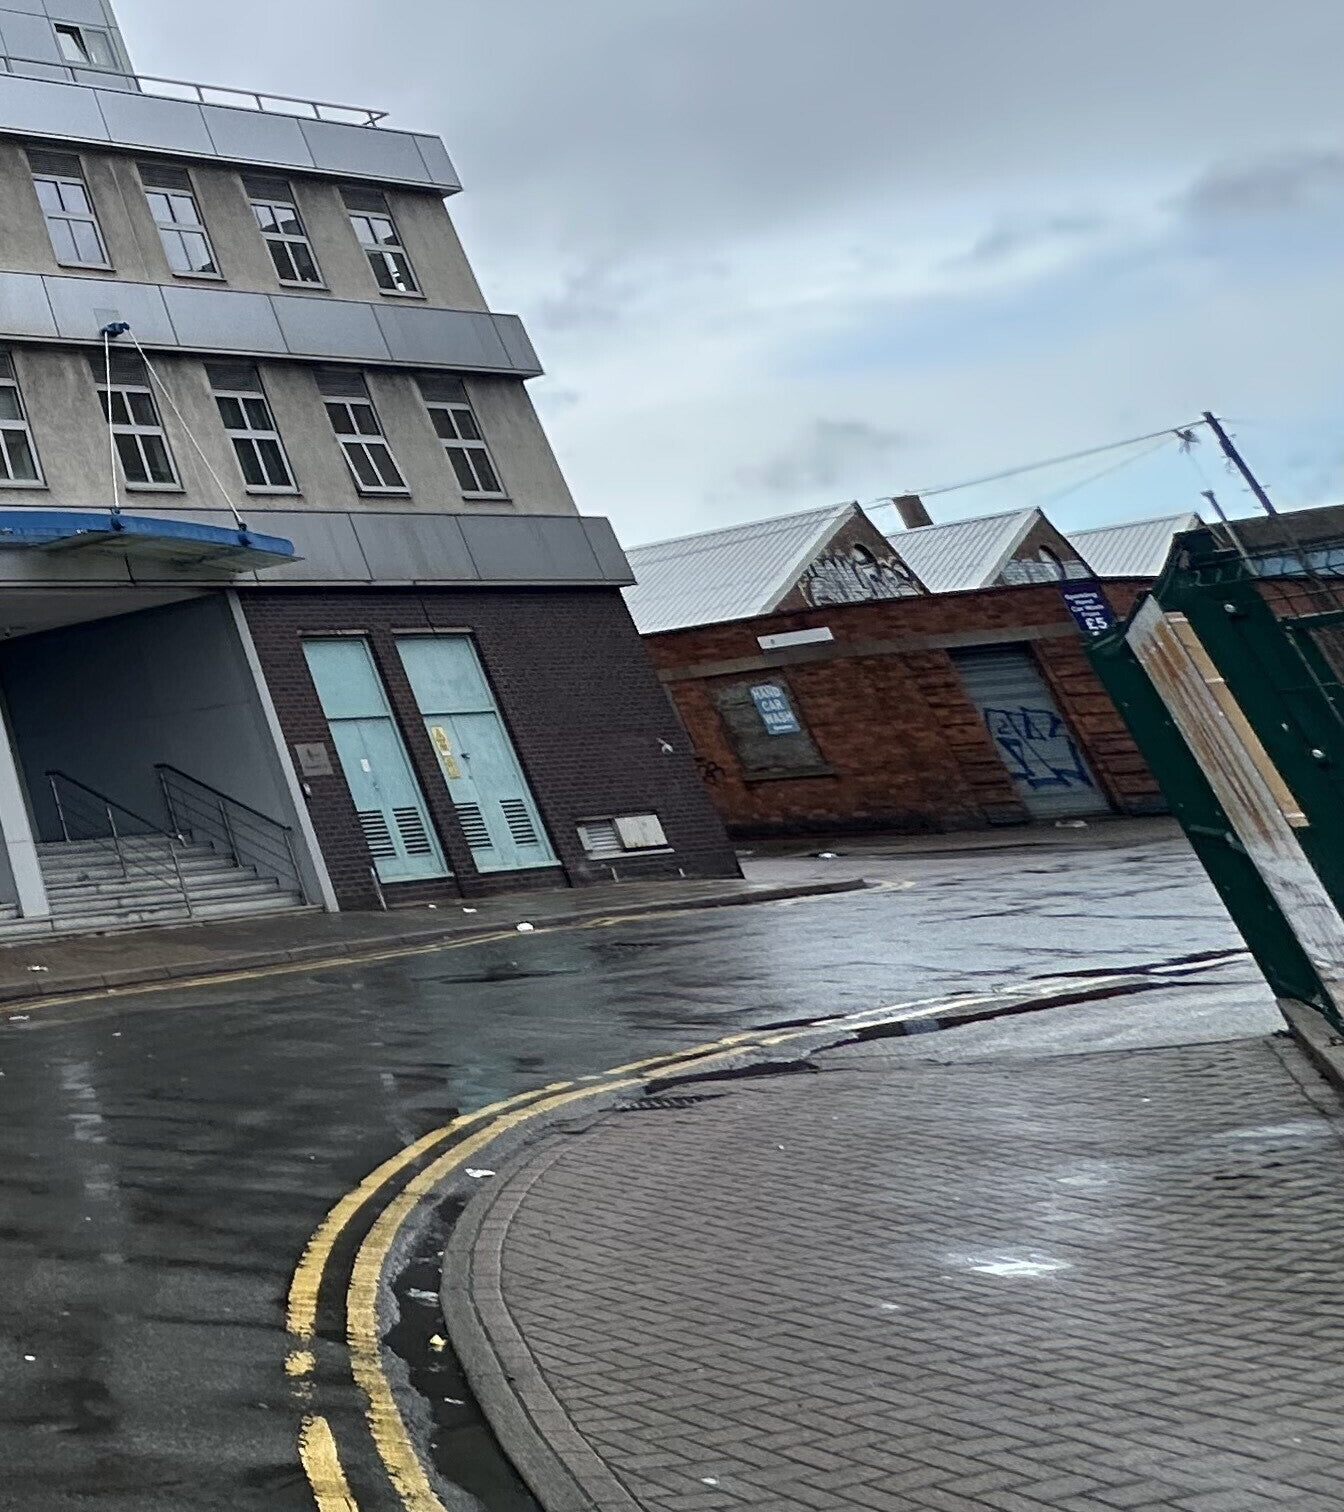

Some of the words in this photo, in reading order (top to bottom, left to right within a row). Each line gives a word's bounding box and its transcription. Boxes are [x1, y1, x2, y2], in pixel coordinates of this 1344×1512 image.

[751, 685, 782, 699] HAND
[762, 699, 785, 712] CAR
[763, 711, 795, 724] WASH
